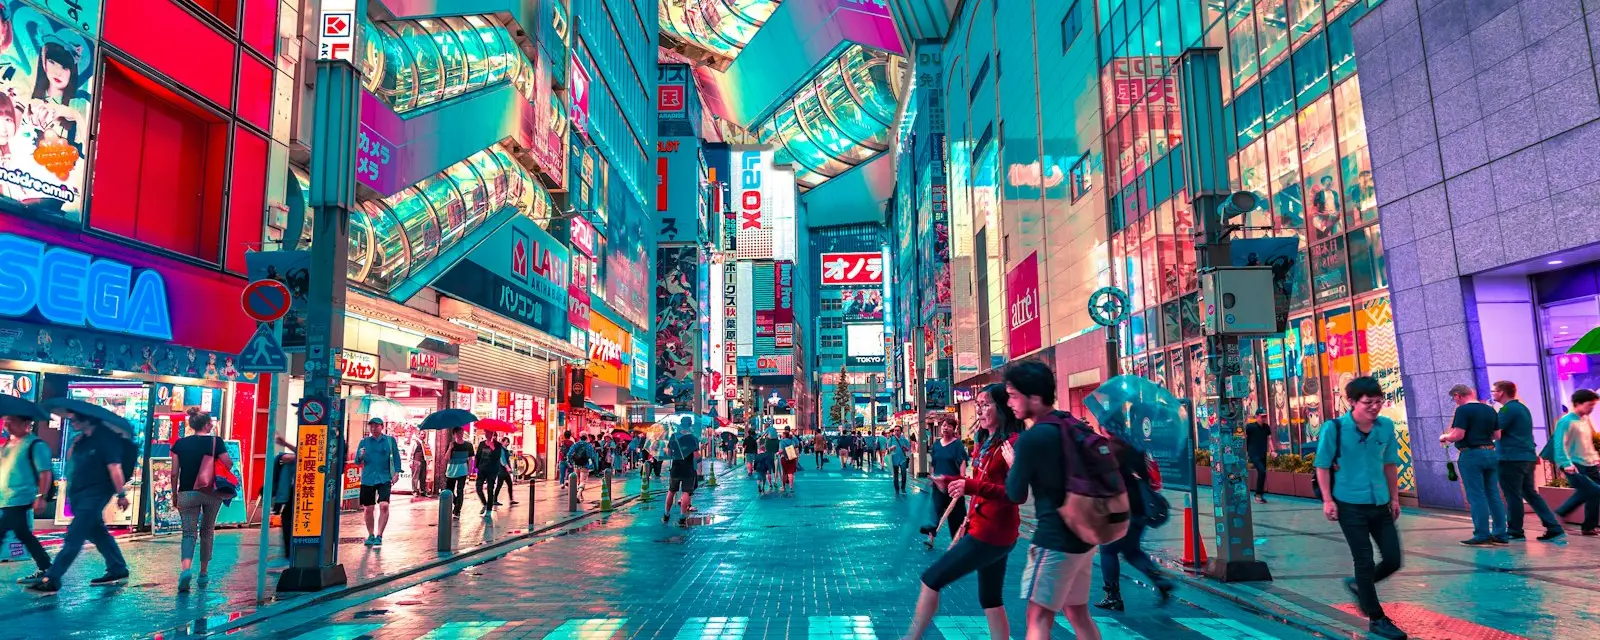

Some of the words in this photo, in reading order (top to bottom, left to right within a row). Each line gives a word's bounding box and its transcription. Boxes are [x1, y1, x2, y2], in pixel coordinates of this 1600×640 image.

[358, 131, 390, 165] カメラ
[357, 157, 379, 181] メラ
[0, 232, 173, 340] SEGA
[1011, 287, 1032, 328] atré
[301, 433, 317, 532] 路上喫煙禁止です。
